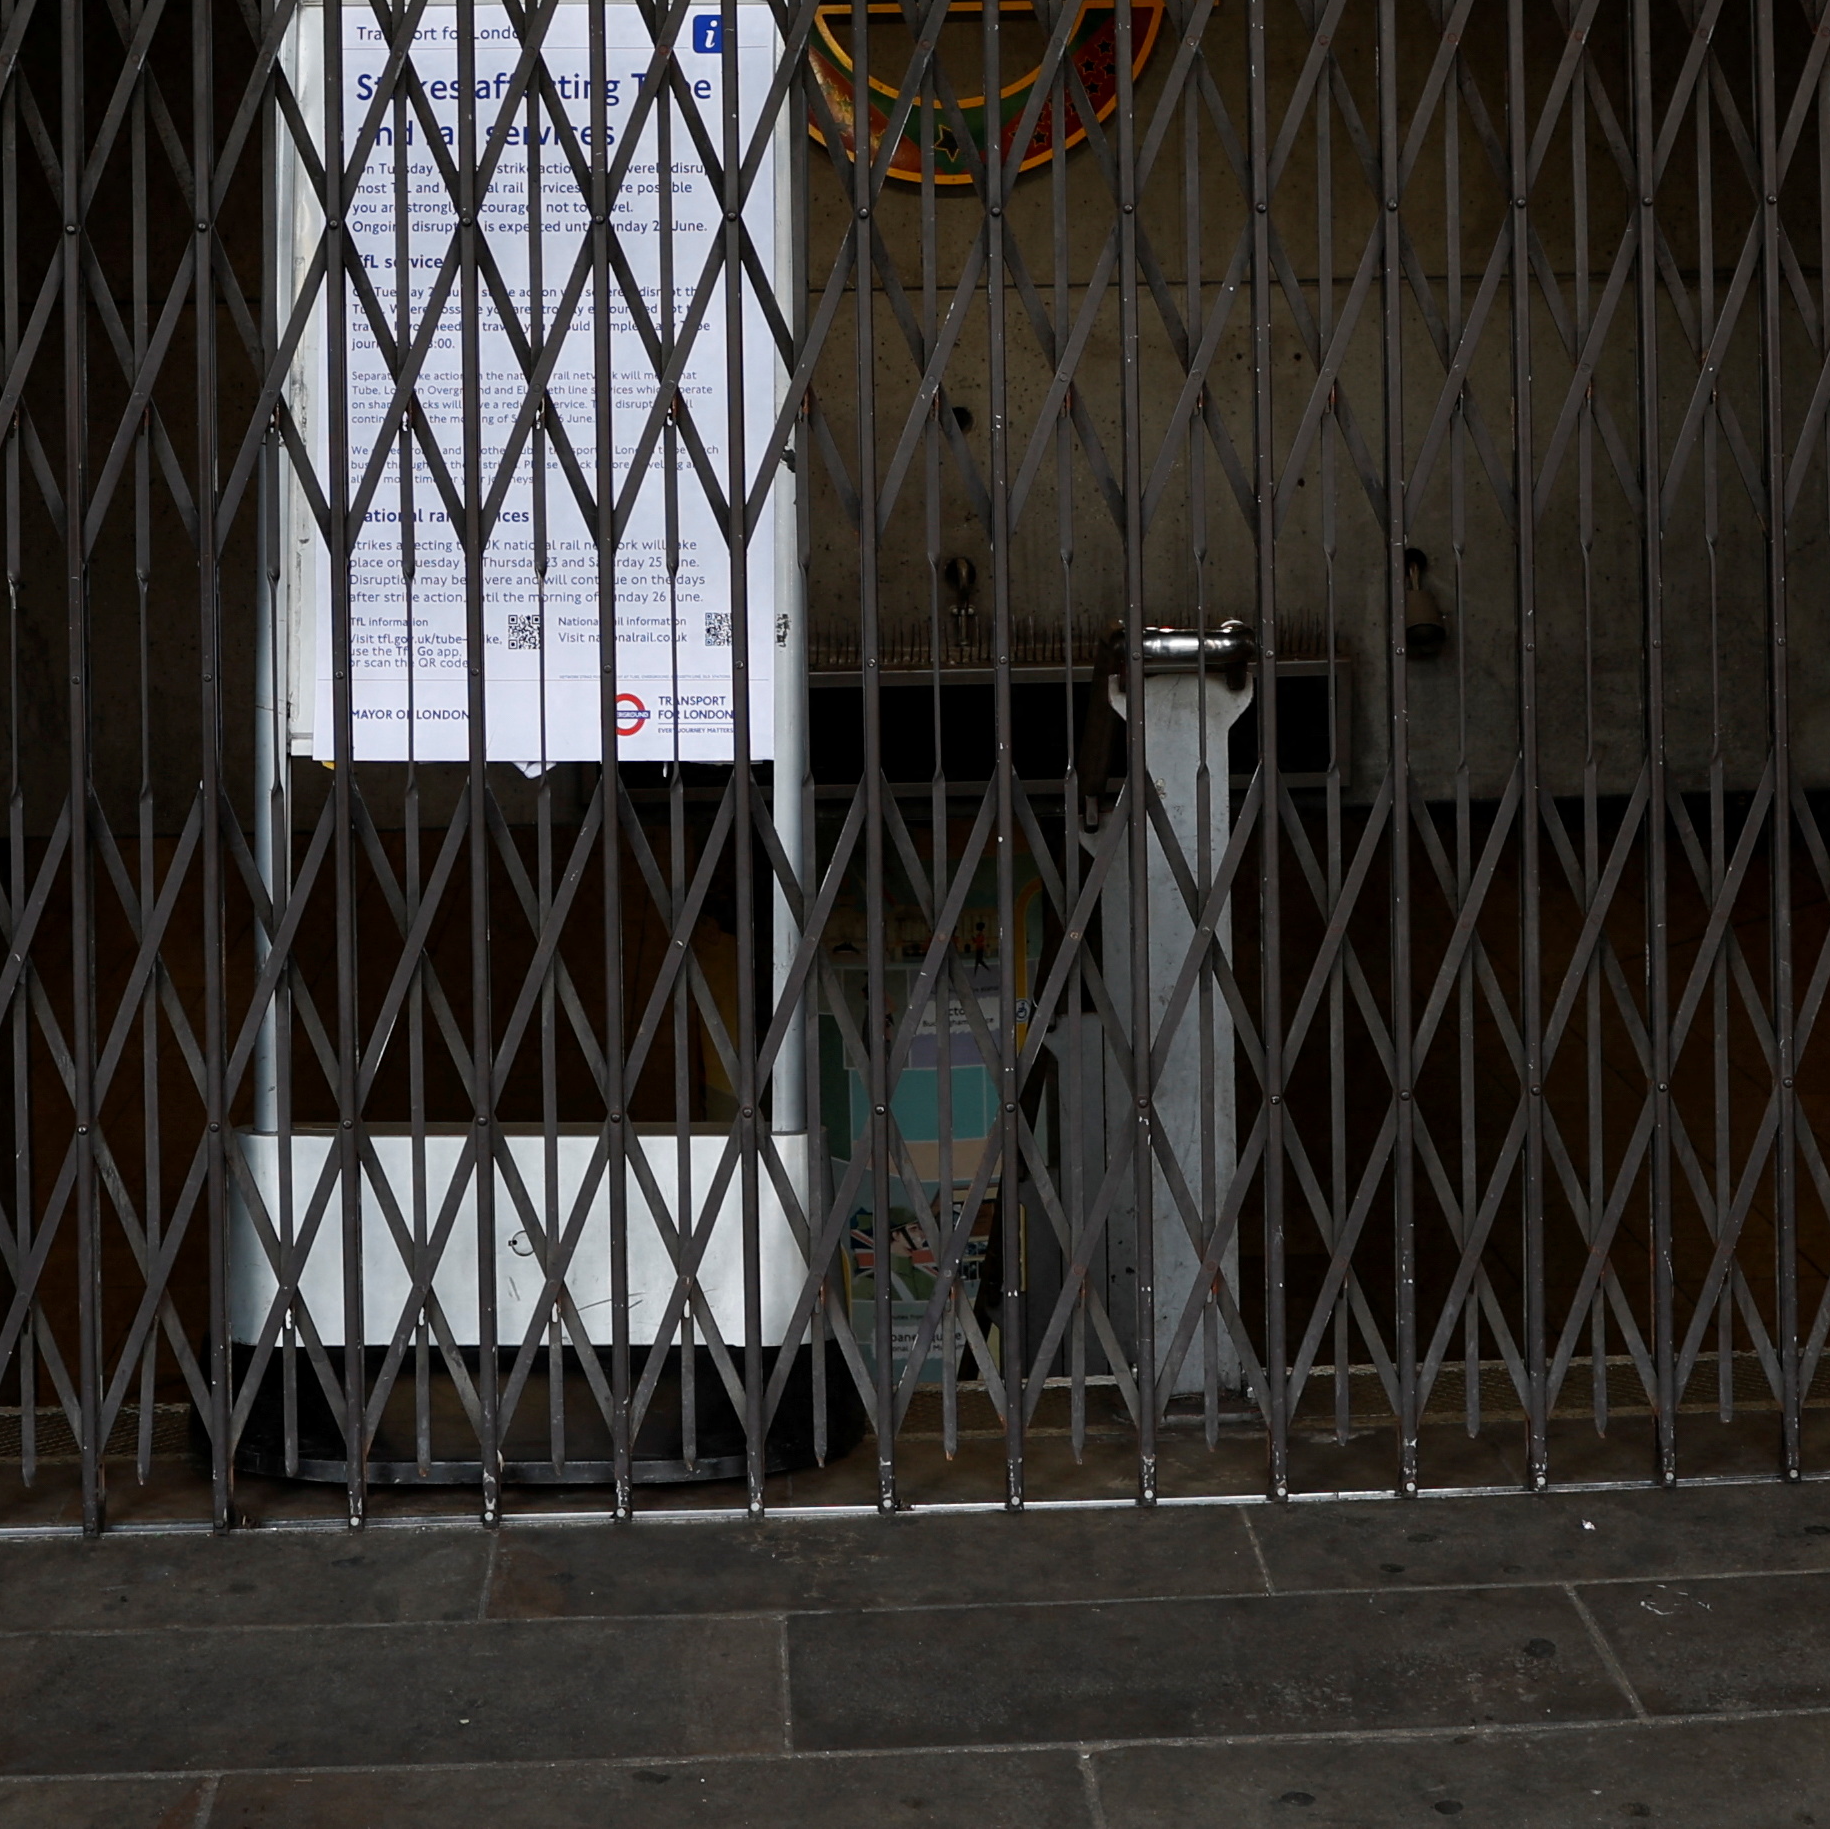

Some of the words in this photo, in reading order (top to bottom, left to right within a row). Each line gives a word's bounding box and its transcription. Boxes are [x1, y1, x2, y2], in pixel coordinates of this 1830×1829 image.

[558, 539, 579, 550] rail
[642, 539, 664, 550] will
[562, 557, 585, 568] and
[420, 574, 447, 587] may
[677, 574, 706, 587] days
[503, 592, 525, 603] the
[350, 617, 367, 627] TfL
[417, 646, 434, 657] Go
[418, 658, 437, 669] QR
[658, 695, 726, 706] TRANSPORT
[351, 709, 395, 720] MAYOR
[416, 709, 470, 720] LONDON
